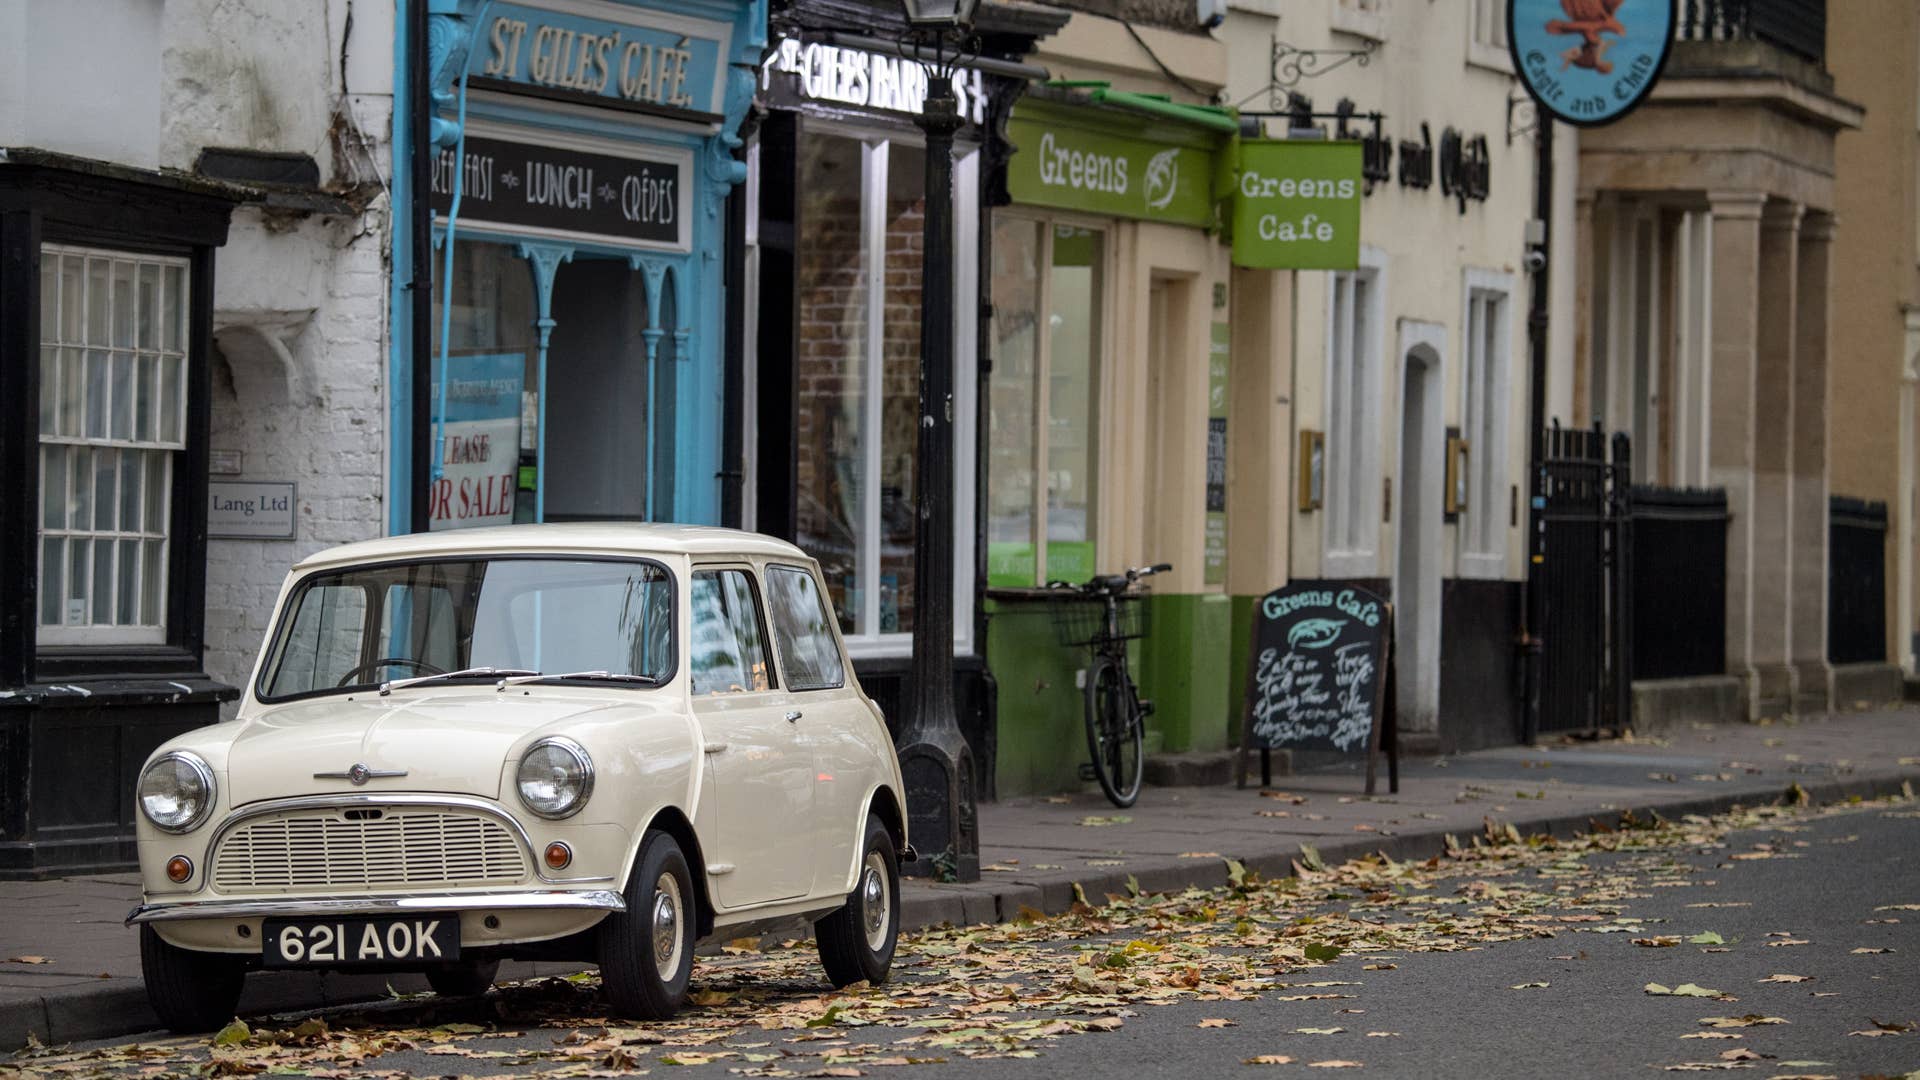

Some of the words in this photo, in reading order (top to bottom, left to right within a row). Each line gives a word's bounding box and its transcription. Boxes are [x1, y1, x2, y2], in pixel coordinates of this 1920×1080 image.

[486, 16, 527, 78] ST
[531, 25, 620, 95] GILES'
[1526, 49, 1565, 101] Eagle
[1570, 95, 1606, 114] and
[1613, 53, 1653, 99] Child
[1039, 132, 1128, 195] Greens
[526, 160, 593, 210] LUNCH
[622, 168, 674, 225] CRÊPES
[1240, 172, 1356, 200] Greens
[1258, 214, 1334, 242] Cafe
[213, 496, 255, 516] Lang
[260, 496, 288, 511] Ltd
[458, 474, 512, 519] SALE
[1262, 591, 1333, 620] Greens
[1336, 590, 1380, 627] Cafe
[279, 924, 345, 962] 621
[358, 920, 442, 960] AOK
